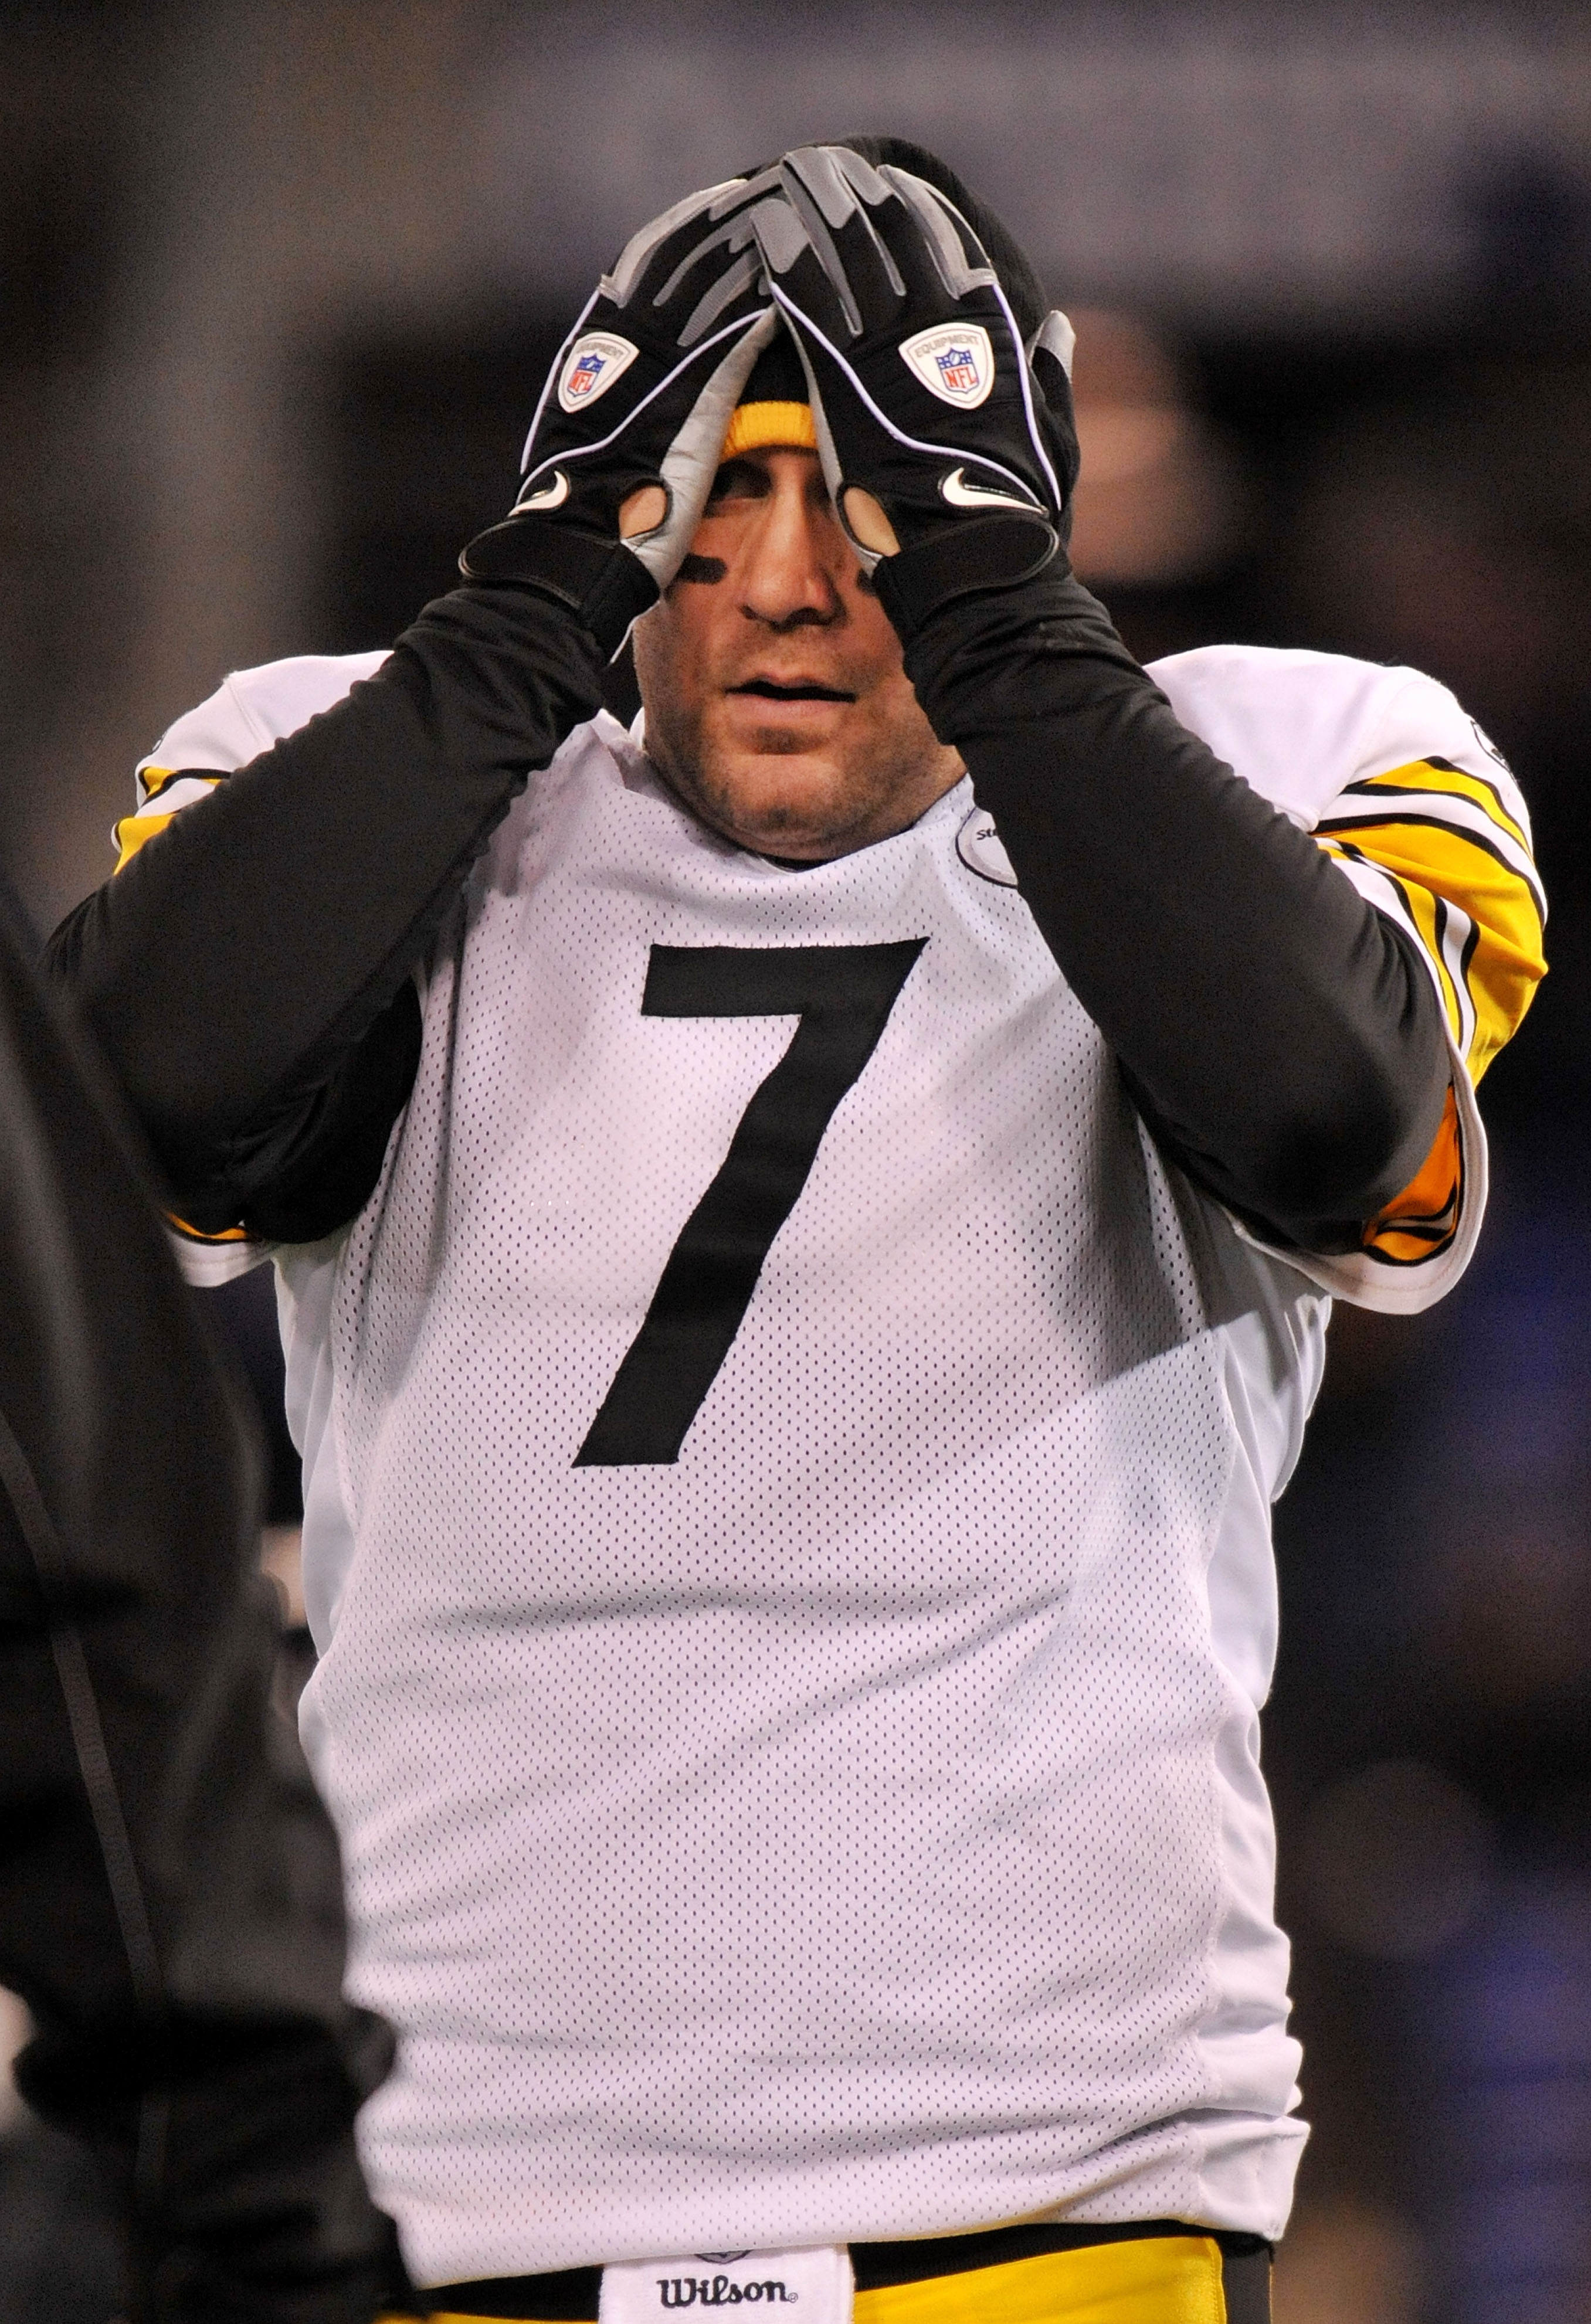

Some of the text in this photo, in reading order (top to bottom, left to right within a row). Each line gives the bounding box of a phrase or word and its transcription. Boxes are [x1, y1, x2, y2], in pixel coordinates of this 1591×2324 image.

[945, 367, 978, 388] NFL
[571, 935, 930, 1468] 7
[656, 2275, 790, 2308] Wilson
